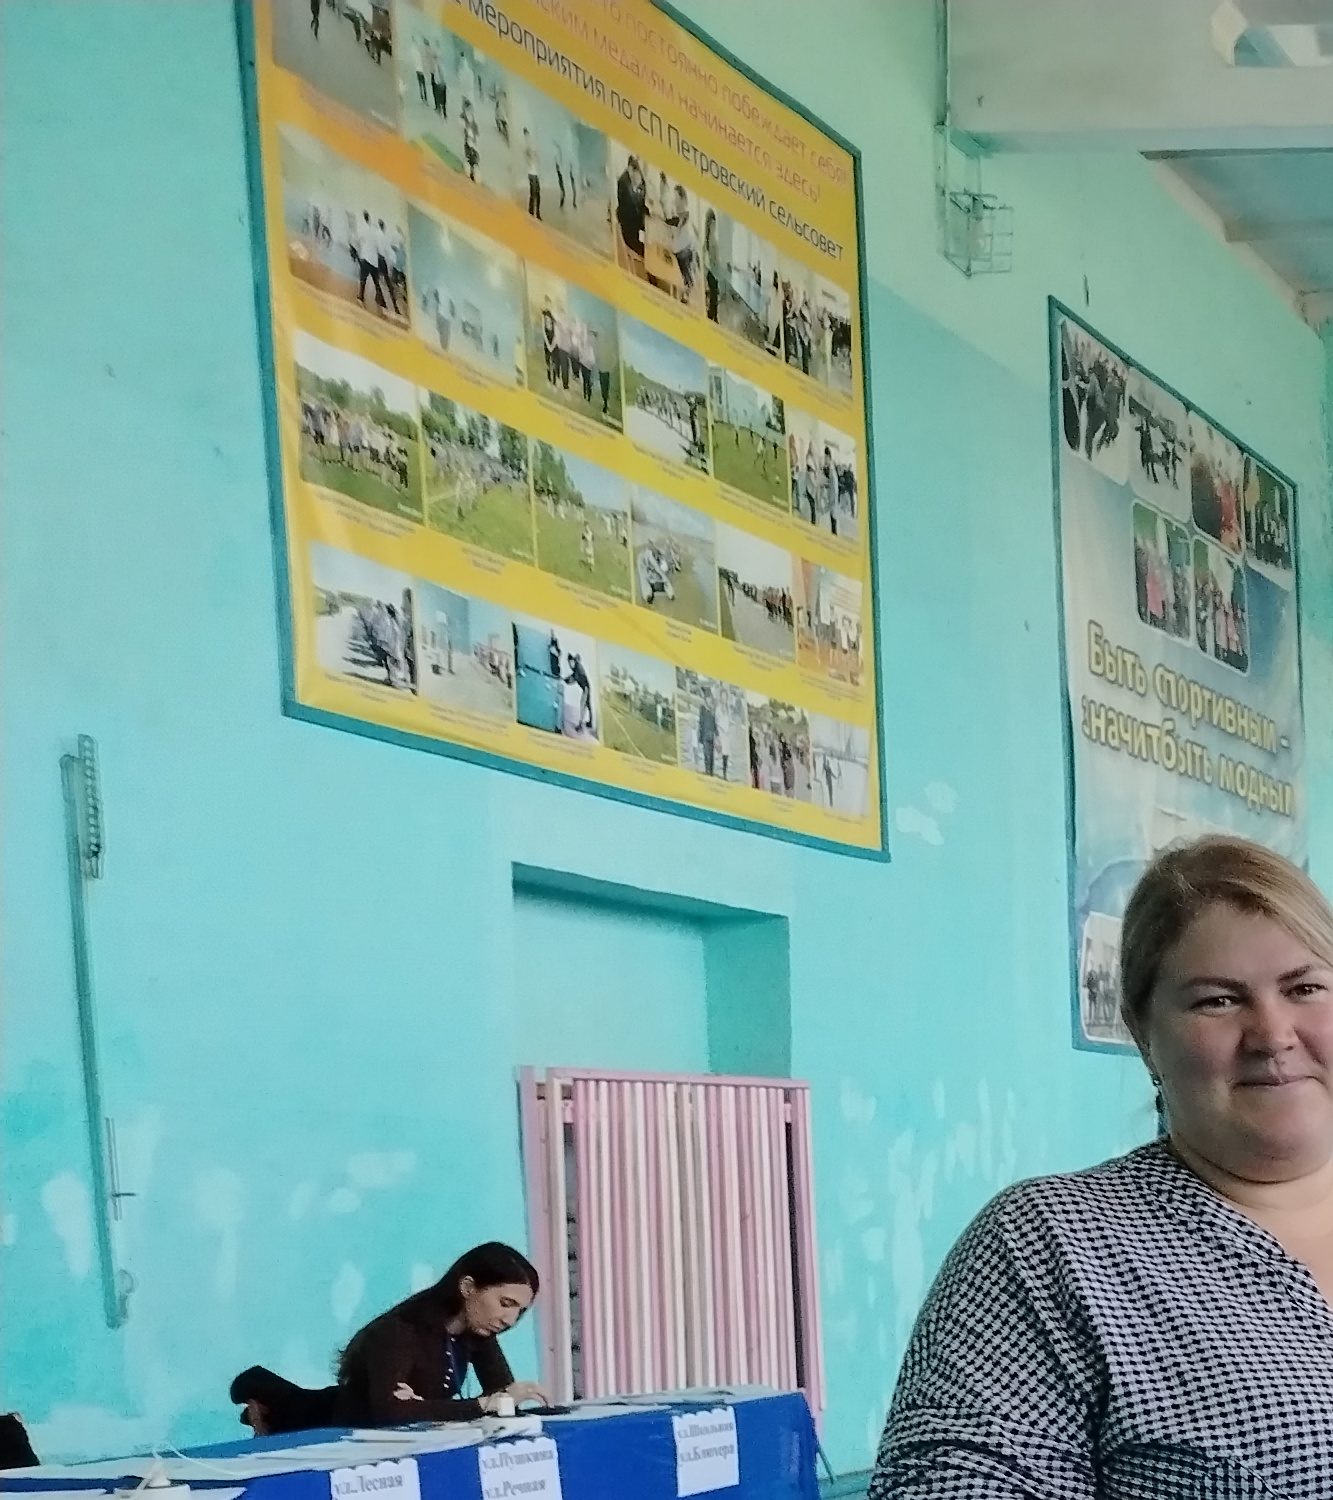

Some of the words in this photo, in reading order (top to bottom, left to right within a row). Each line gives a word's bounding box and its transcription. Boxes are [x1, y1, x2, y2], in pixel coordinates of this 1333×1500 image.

[593, 27, 674, 101] медалям
[678, 90, 772, 168] начинается
[625, 11, 718, 95] постоянно
[467, 0, 606, 104] Мероприятия
[610, 89, 632, 120] по
[637, 104, 663, 143] СП
[667, 123, 766, 213] Петровский
[769, 200, 844, 262] сельсовет
[1088, 619, 1148, 698] Быть
